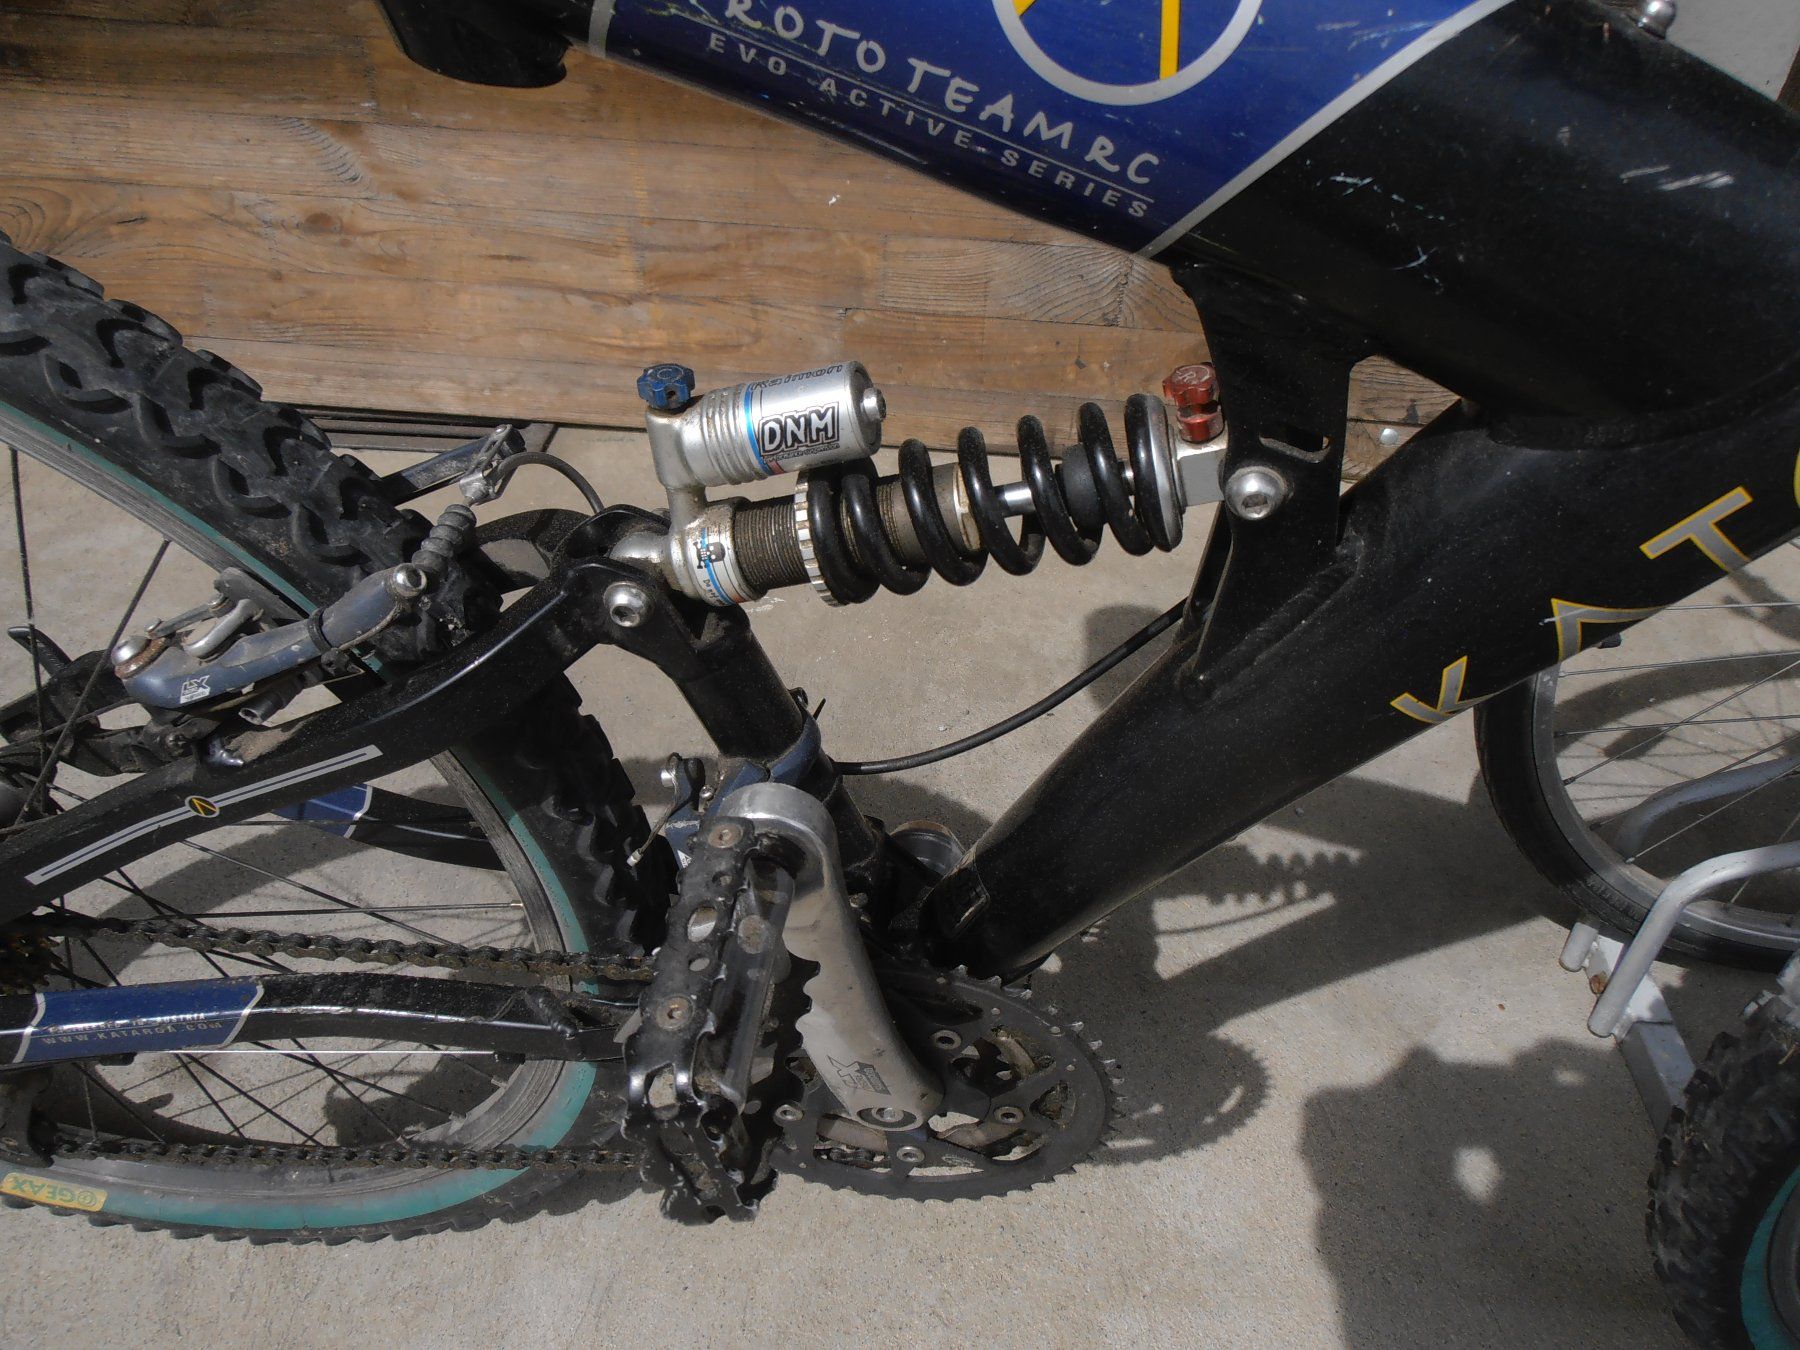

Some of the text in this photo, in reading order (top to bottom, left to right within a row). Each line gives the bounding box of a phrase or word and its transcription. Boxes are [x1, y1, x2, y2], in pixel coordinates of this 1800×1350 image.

[709, 32, 1148, 217] EVO ACTIVE SERIES
[760, 404, 838, 454] DNM
[10, 1177, 77, 1203] GEAX
